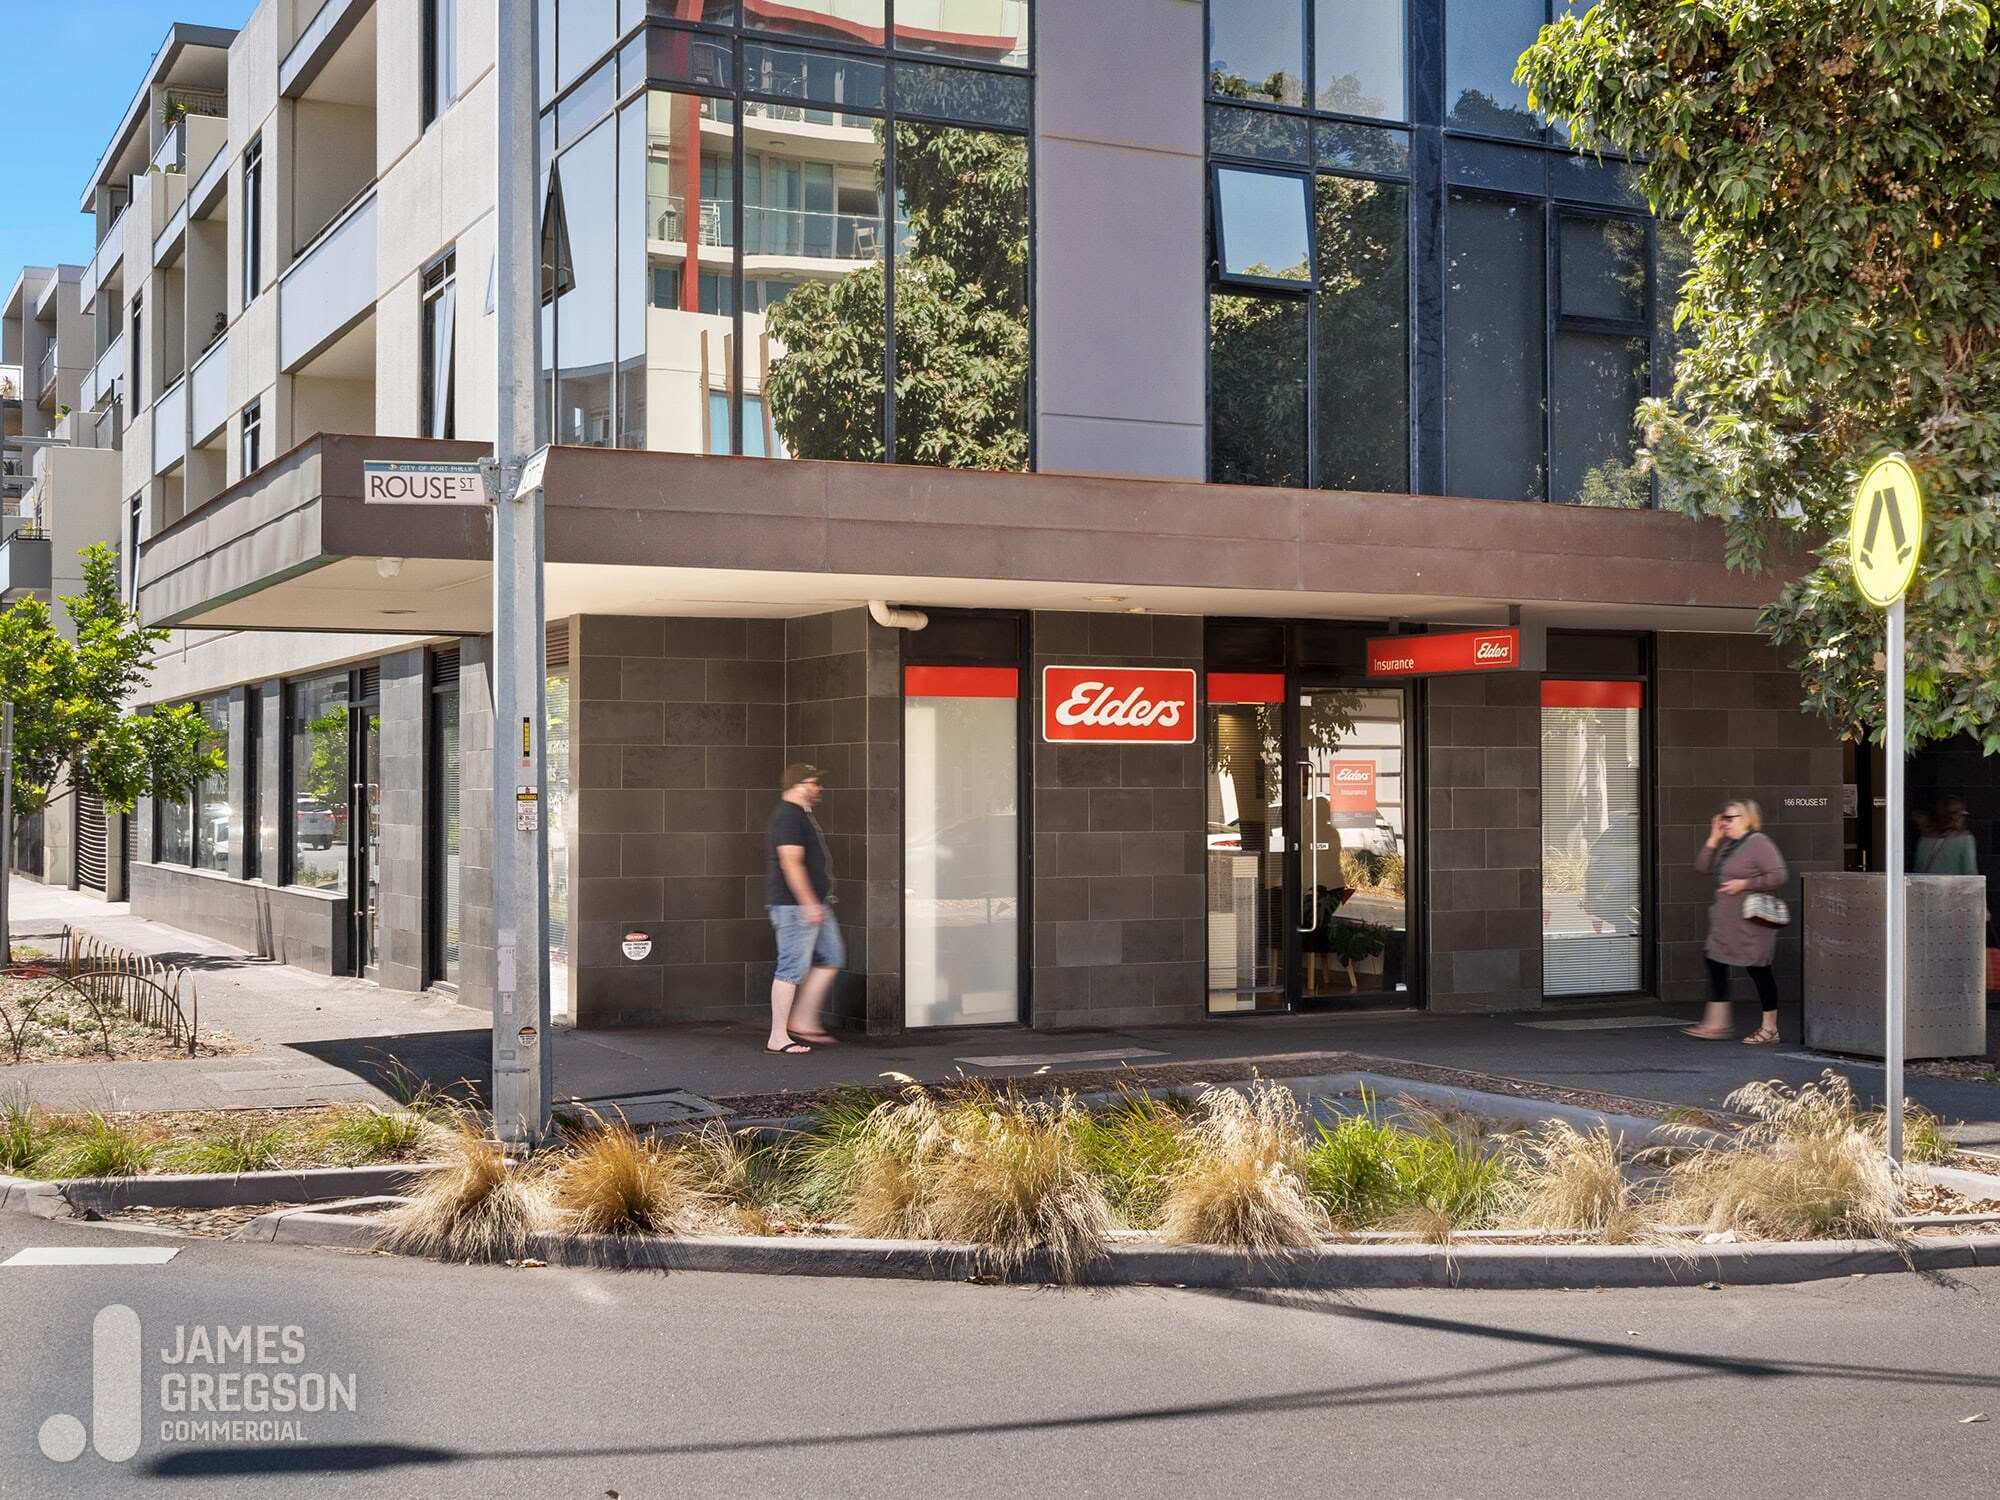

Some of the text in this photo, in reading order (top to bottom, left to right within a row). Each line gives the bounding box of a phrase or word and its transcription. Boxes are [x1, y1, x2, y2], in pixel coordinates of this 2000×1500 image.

[371, 475, 475, 499] ROUSE ST
[1477, 642, 1509, 659] Elders
[1374, 658, 1414, 671] Insurance
[1055, 681, 1186, 728] Elders
[1336, 768, 1370, 781] Elders
[1795, 798, 1818, 806] ROUSE
[1819, 798, 1828, 806] ST
